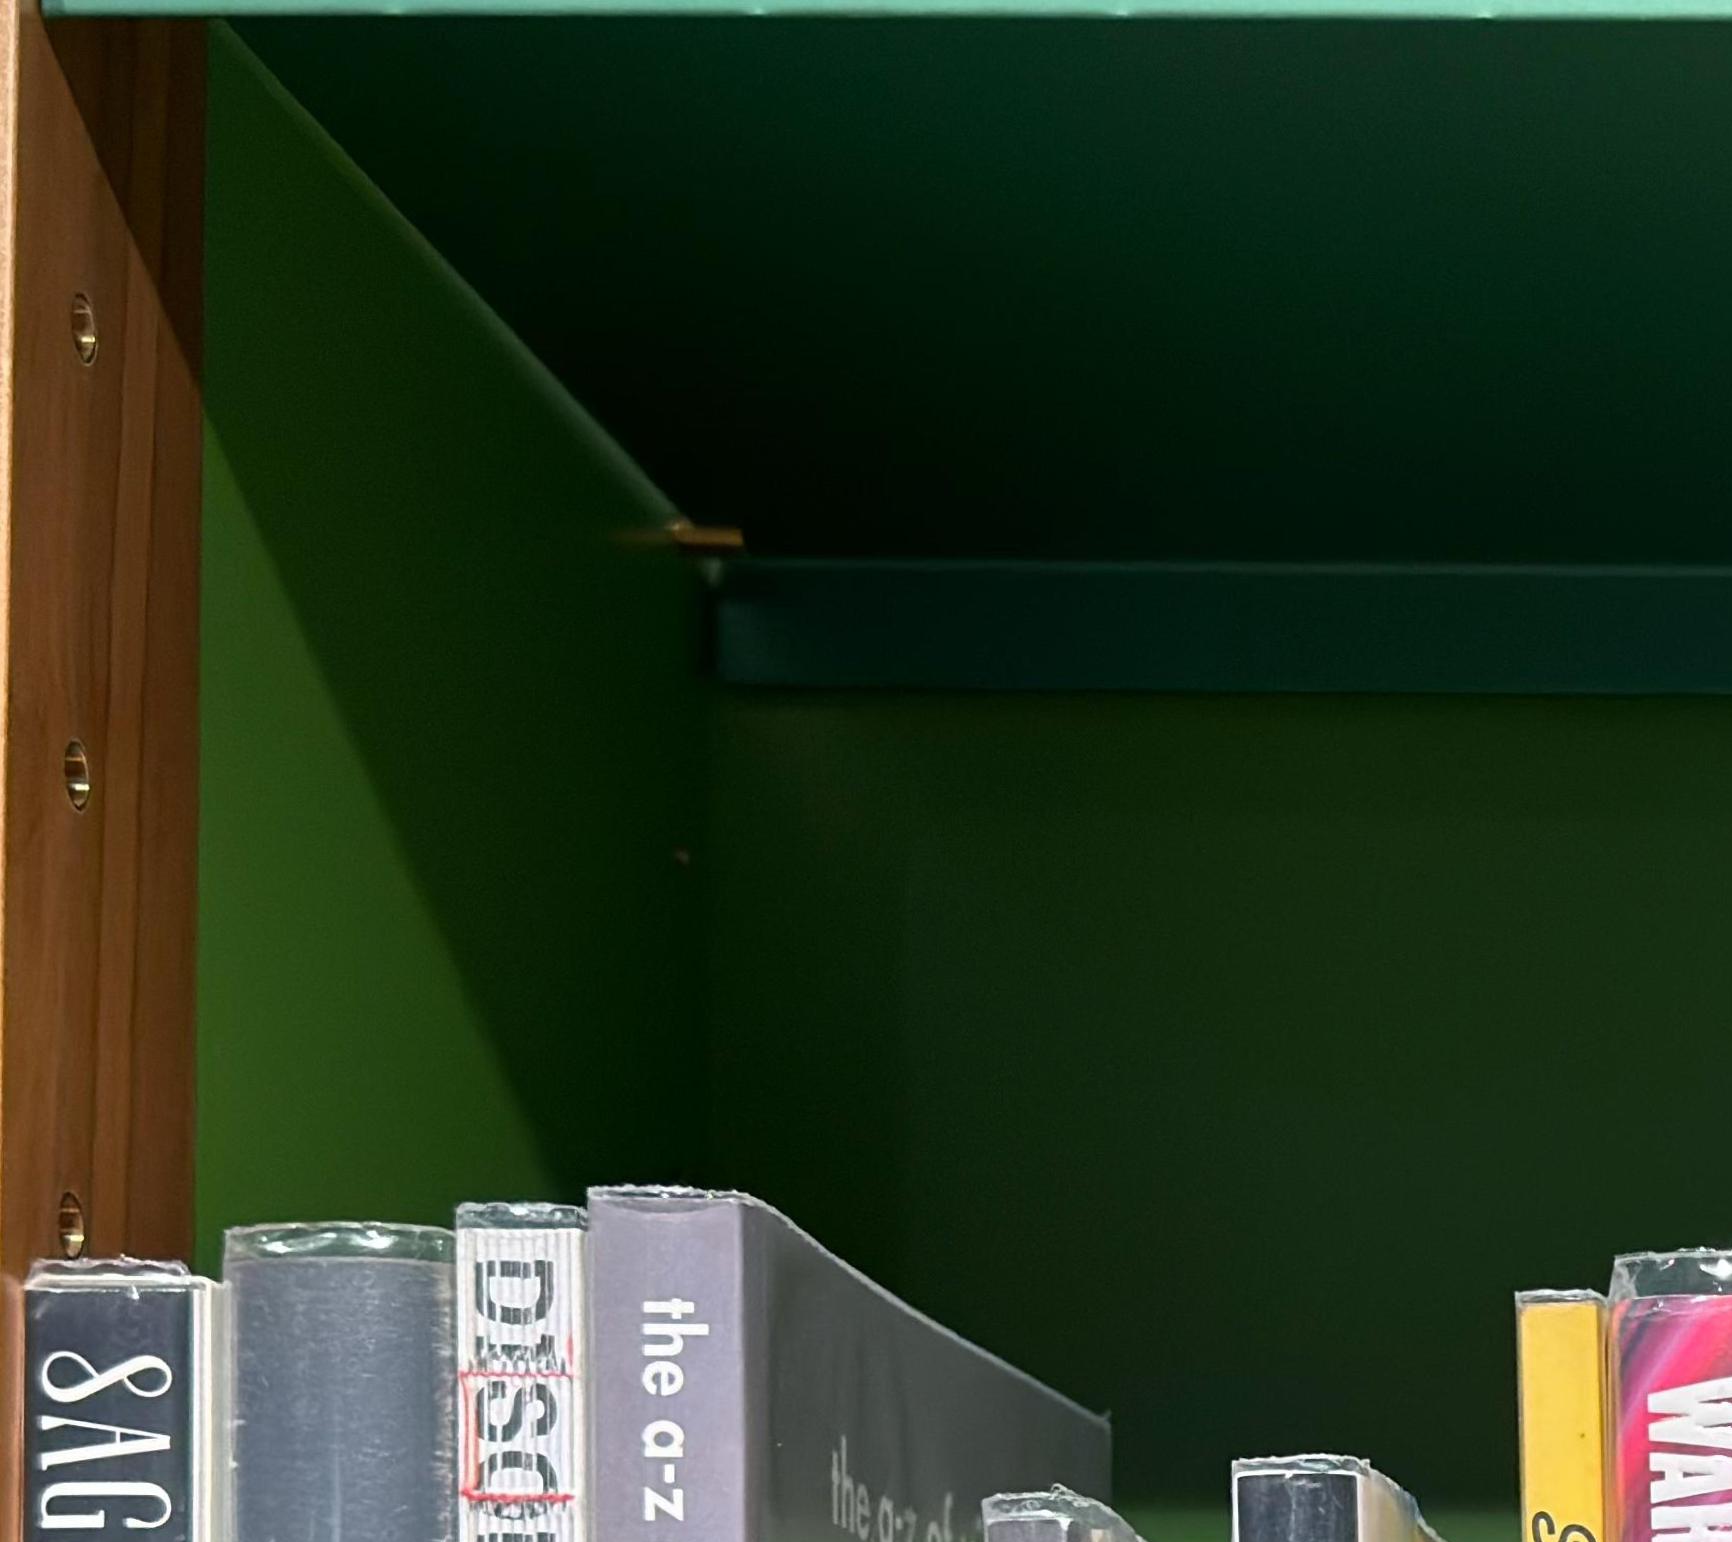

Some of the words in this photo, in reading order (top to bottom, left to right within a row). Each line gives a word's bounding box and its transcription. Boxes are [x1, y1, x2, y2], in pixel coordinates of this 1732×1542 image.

[641, 1298, 709, 1394] the
[641, 1420, 688, 1522] a-z
[831, 1434, 870, 1541] the
